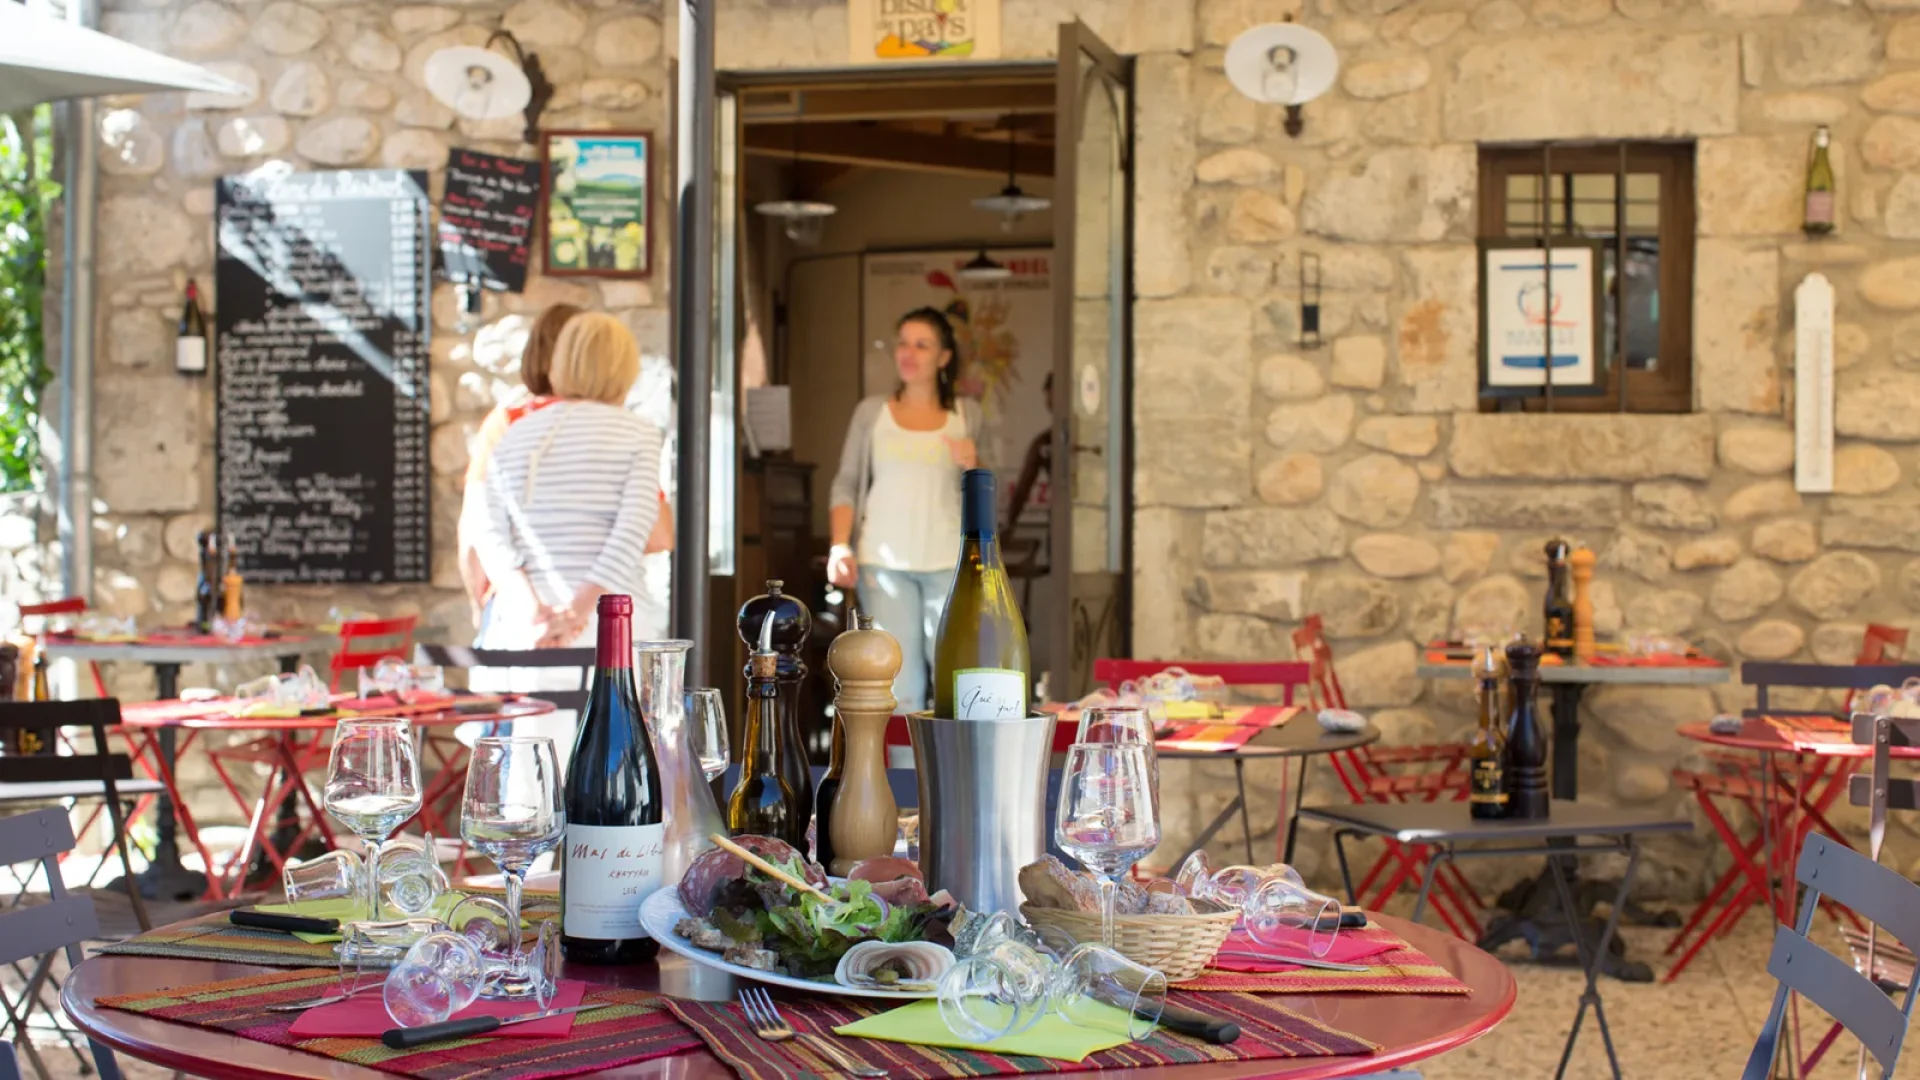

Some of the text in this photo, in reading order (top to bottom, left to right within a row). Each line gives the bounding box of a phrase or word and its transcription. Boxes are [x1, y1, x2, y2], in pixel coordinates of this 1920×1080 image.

[897, 17, 967, 49] pays
[571, 843, 609, 860] Mas
[616, 846, 632, 859] de
